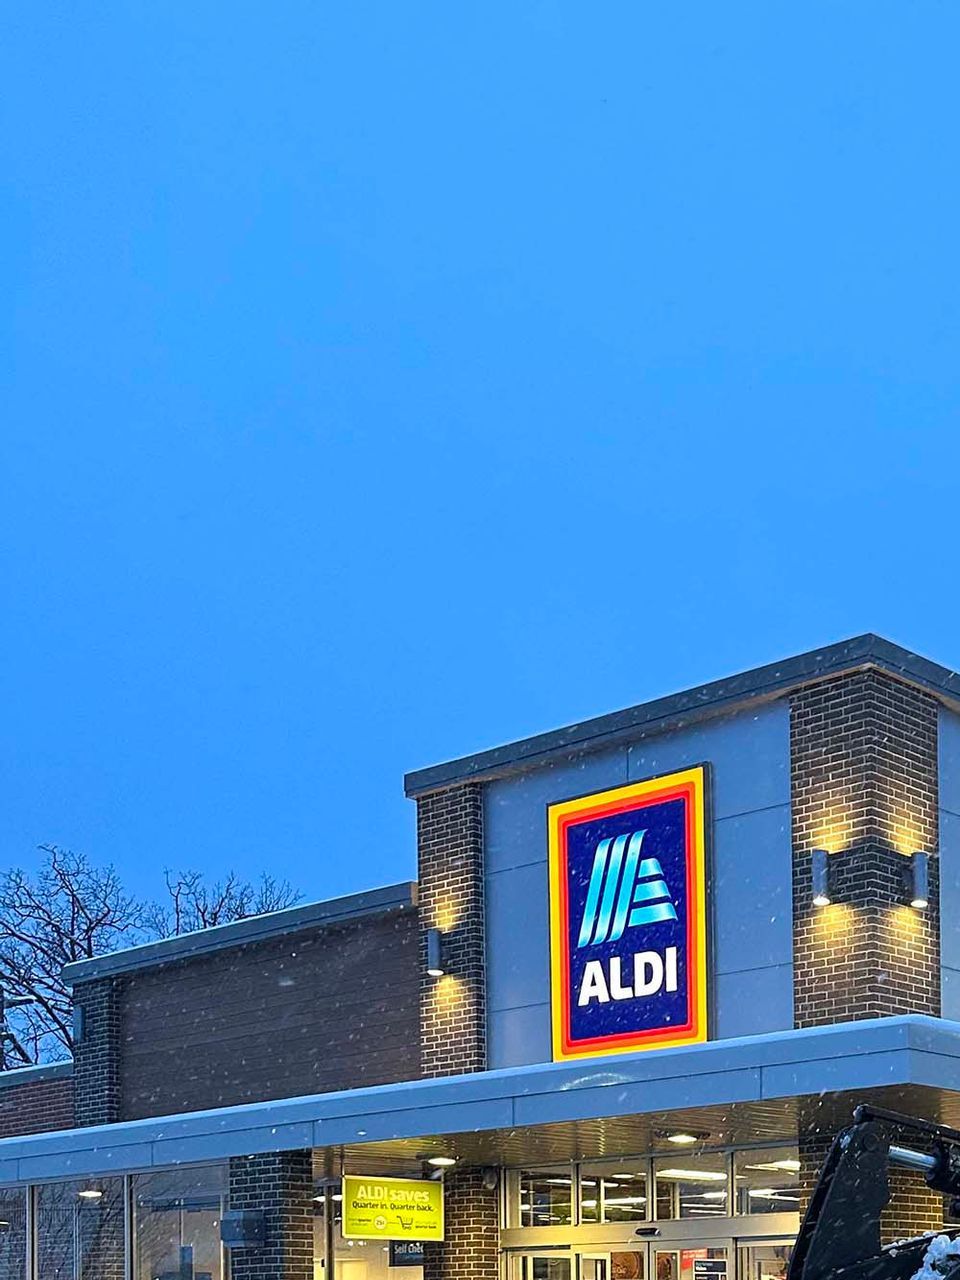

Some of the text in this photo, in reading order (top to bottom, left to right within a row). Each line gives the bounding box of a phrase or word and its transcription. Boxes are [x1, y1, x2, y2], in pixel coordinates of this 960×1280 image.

[577, 946, 678, 1007] ALDI
[357, 1185, 430, 1202] ALDI saves
[353, 1201, 378, 1209] Quarter
[390, 1202, 415, 1211] Quarter
[394, 1243, 408, 1254] Self
